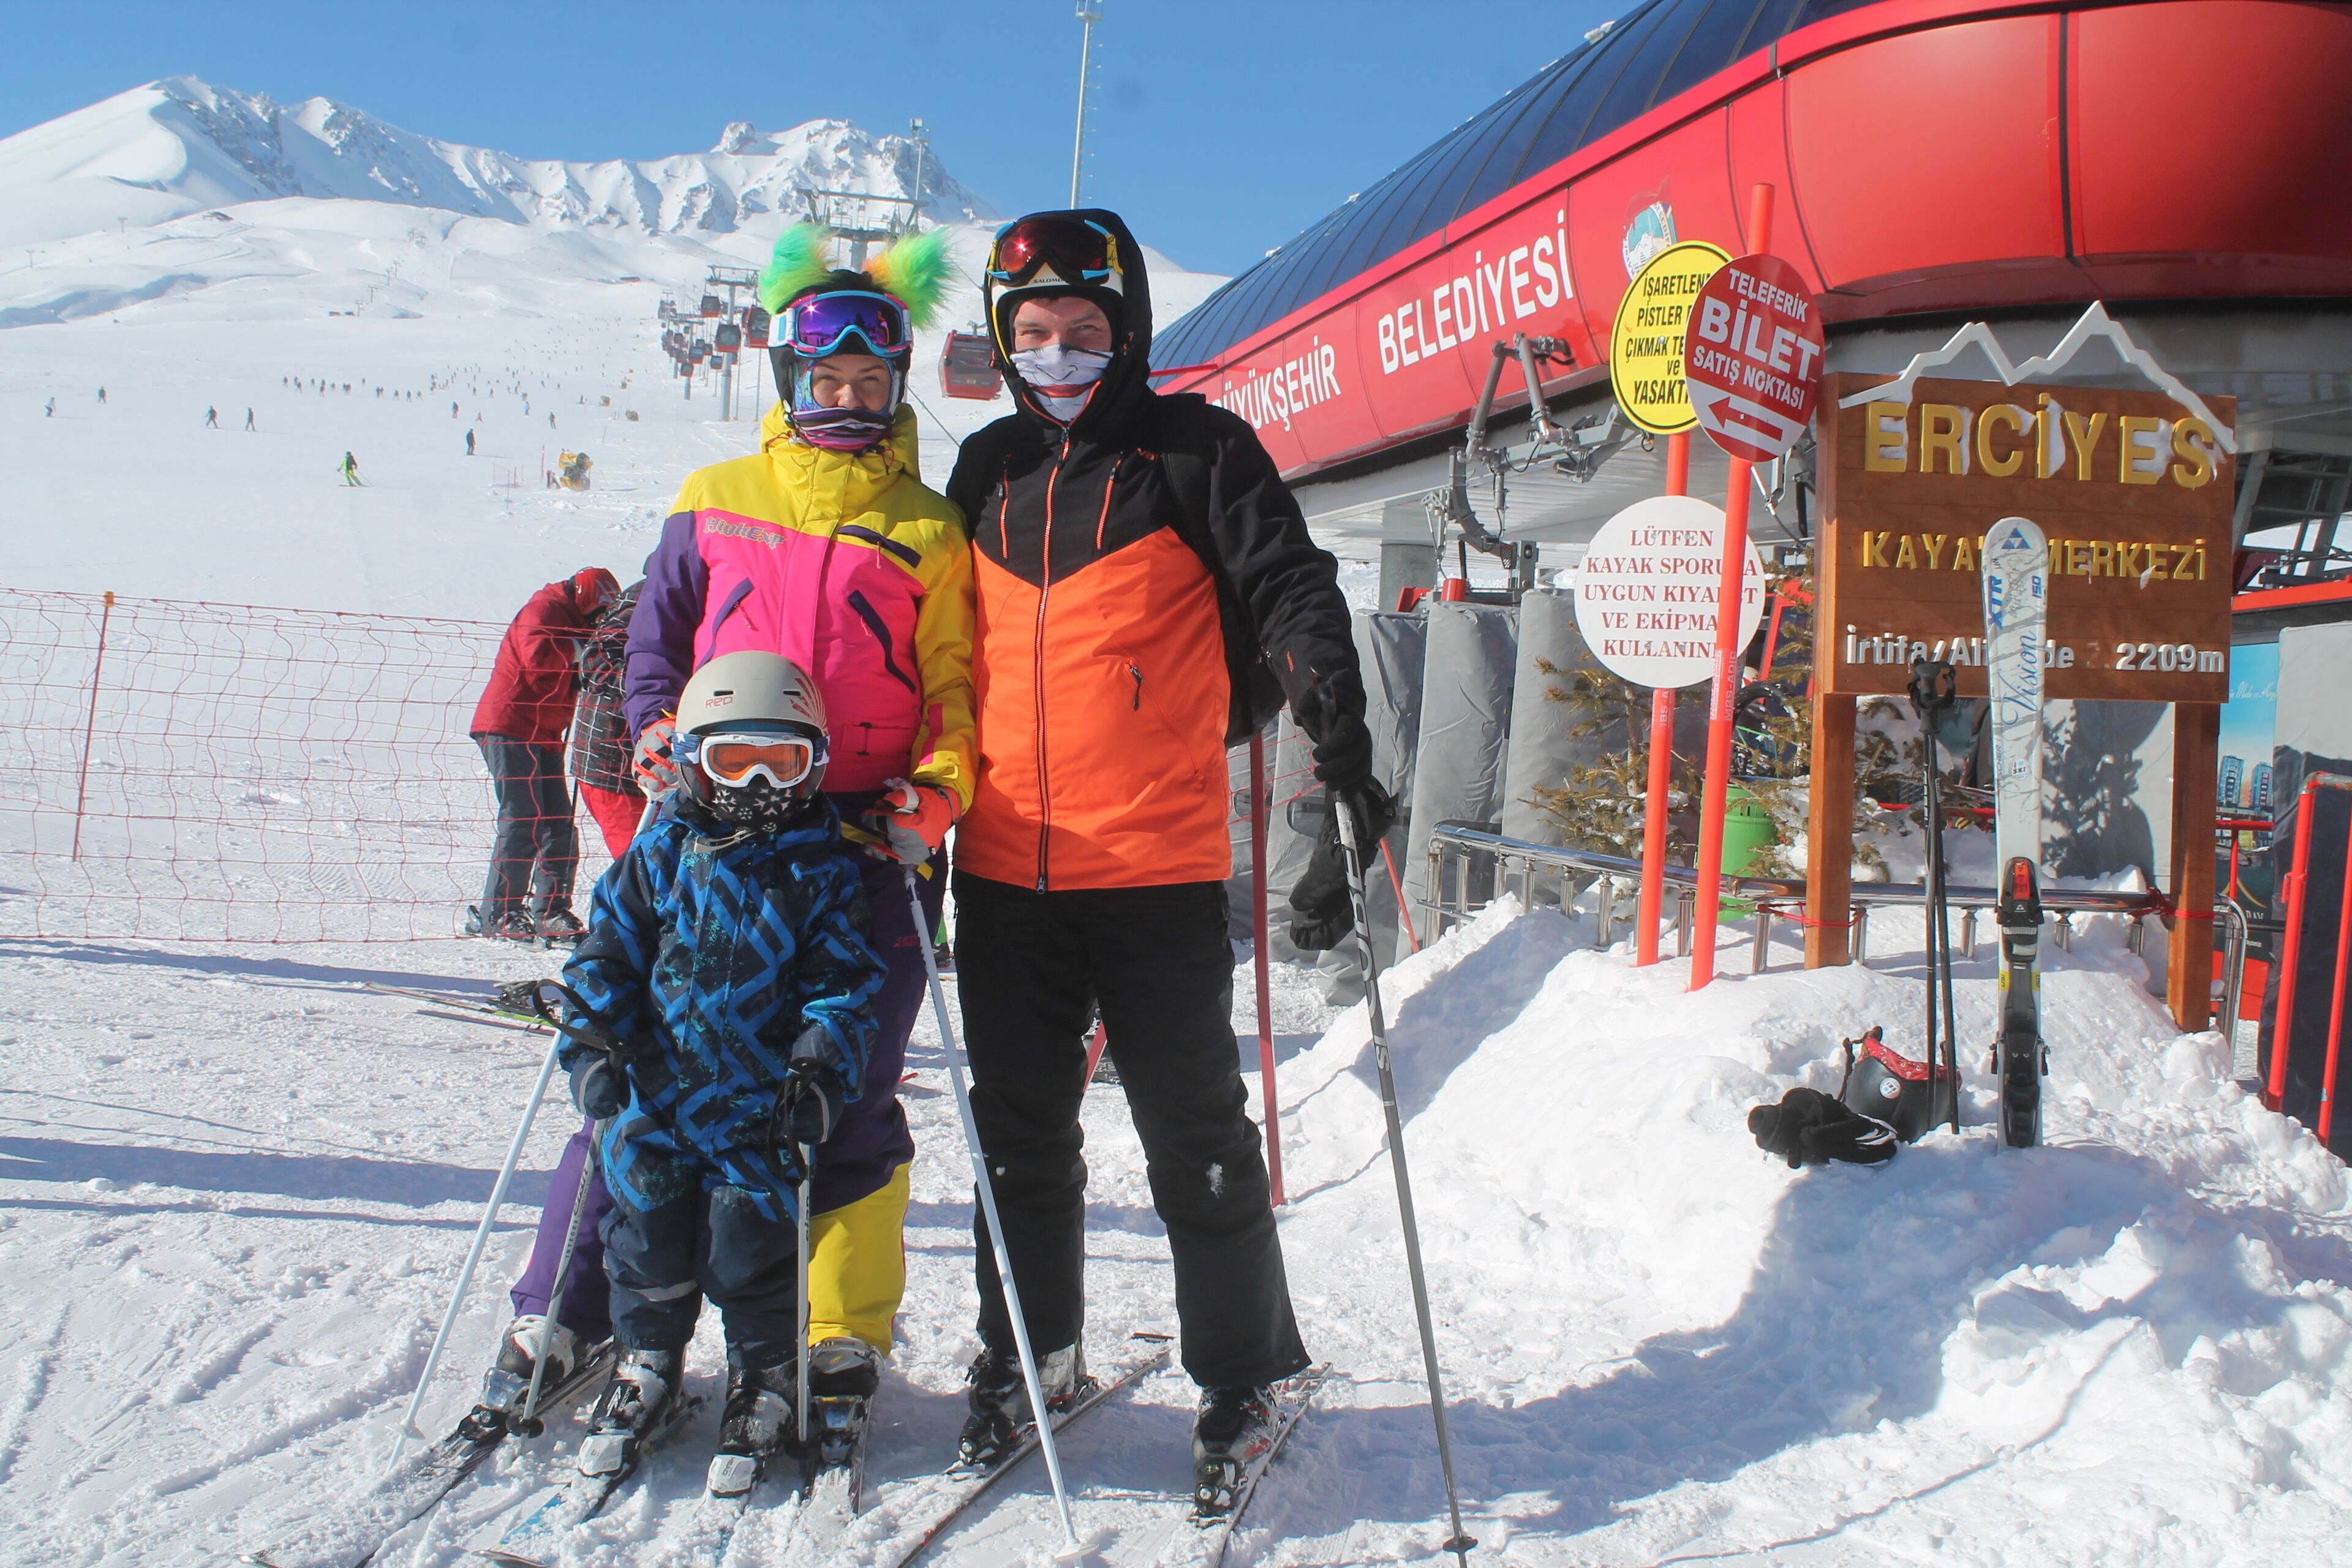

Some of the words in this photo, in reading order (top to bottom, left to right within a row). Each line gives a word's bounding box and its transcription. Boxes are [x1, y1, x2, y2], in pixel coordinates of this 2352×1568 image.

[1643, 273, 1711, 303] İŞARETLEN
[1729, 268, 1808, 323] TELEFERİK
[1212, 335, 1342, 432] ÜYÜKŞEHİR
[1378, 209, 1574, 374] BELEDİYESİ
[1637, 304, 1683, 327] PİSTLER
[1626, 336, 1670, 363] ÇIKMAK
[1698, 295, 1820, 382] BİLET
[1667, 360, 1680, 375] ve
[1694, 345, 1740, 386] SATIŞ
[1743, 365, 1804, 410] NOKTASI
[1865, 393, 2213, 488] ERCİYES
[1630, 525, 1714, 547] LÜTFEN
[1863, 531, 1984, 571] KAYA
[1586, 557, 1653, 573] KAYAK
[1584, 584, 1656, 601] UYGUN
[1988, 575, 2003, 630] XTR
[2032, 576, 2041, 598] 150
[1602, 612, 1628, 628] VE
[1635, 608, 1717, 631] EKİPMA
[2116, 641, 2224, 673] 2209m
[1998, 630, 2037, 725] Vision
[565, 1219, 579, 1258] INTEGRA
